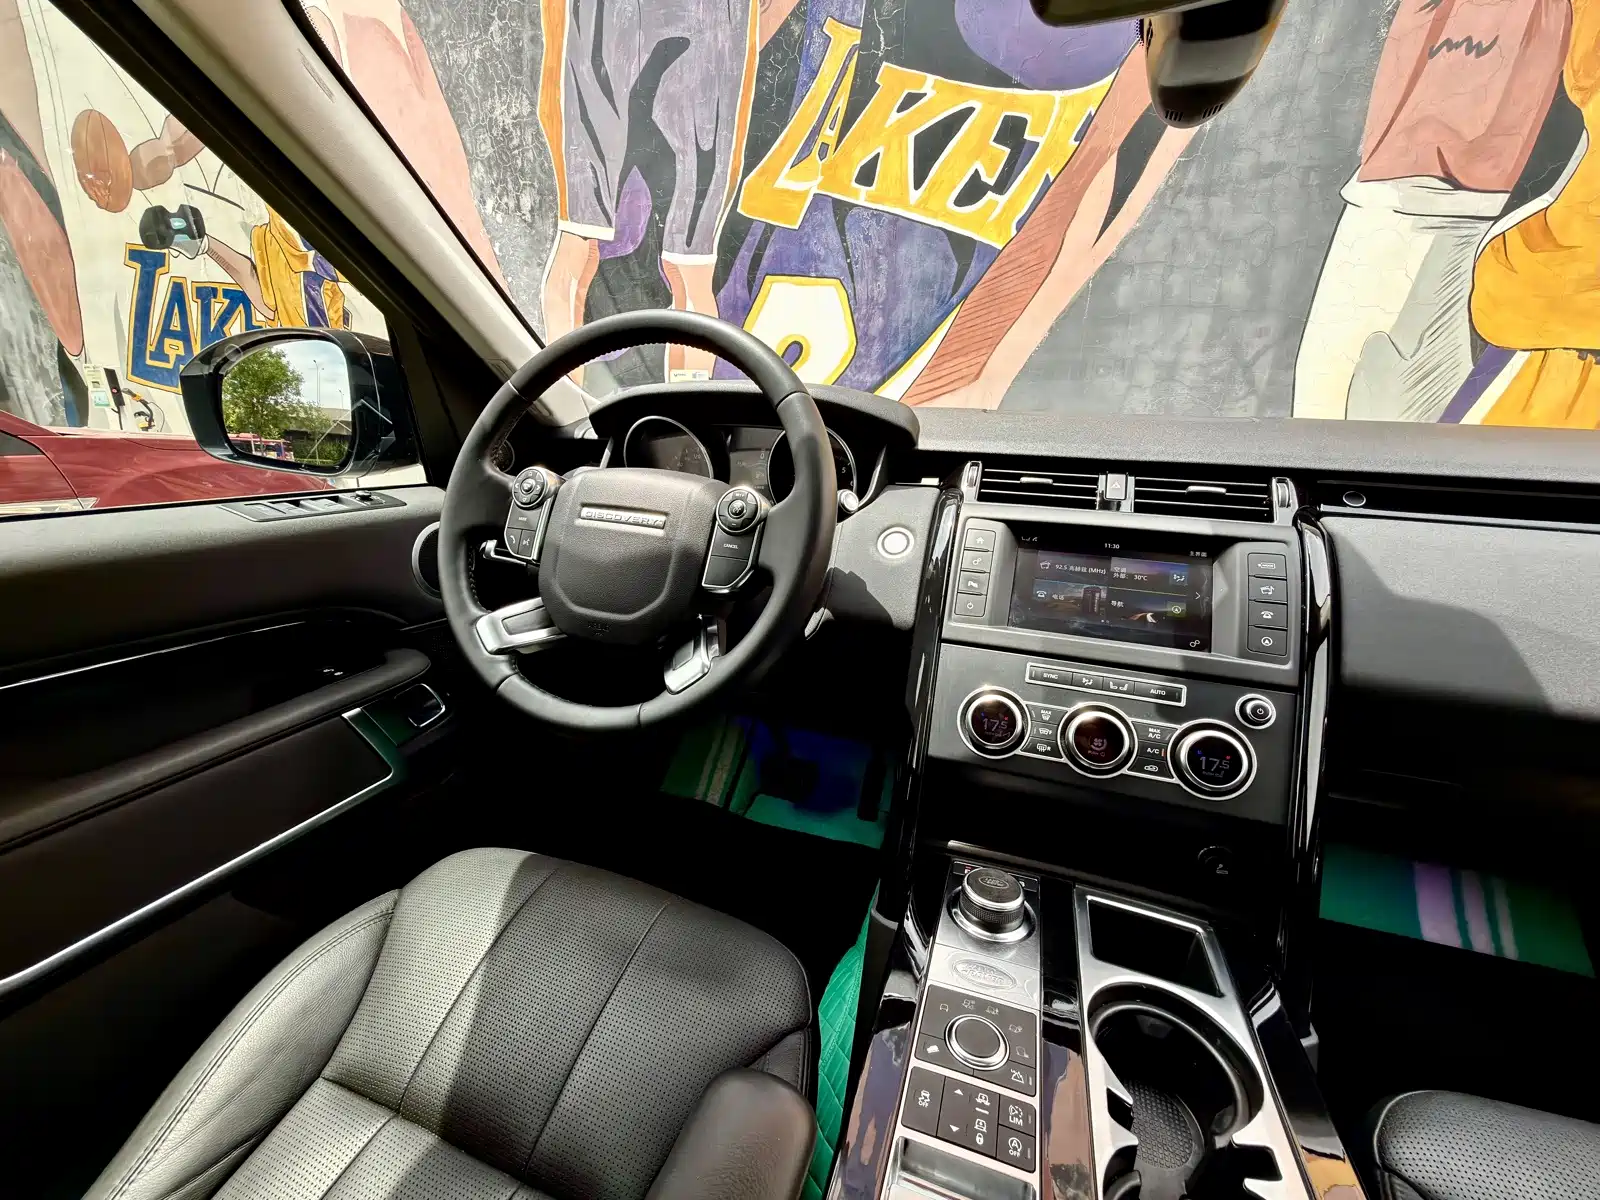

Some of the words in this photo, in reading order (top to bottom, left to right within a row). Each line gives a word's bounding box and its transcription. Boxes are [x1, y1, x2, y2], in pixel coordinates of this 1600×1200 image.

[124, 242, 275, 395] LAK
[584, 510, 661, 526] DISCOVERY
[1055, 563, 1068, 571] 92.5
[1110, 600, 1124, 608] 导航
[1043, 672, 1059, 680] SYNC
[1150, 688, 1166, 696] AUTO
[918, 1100, 929, 1108] OFF
[1008, 1115, 1023, 1126] LIM
[1008, 1149, 1021, 1157] OFF
